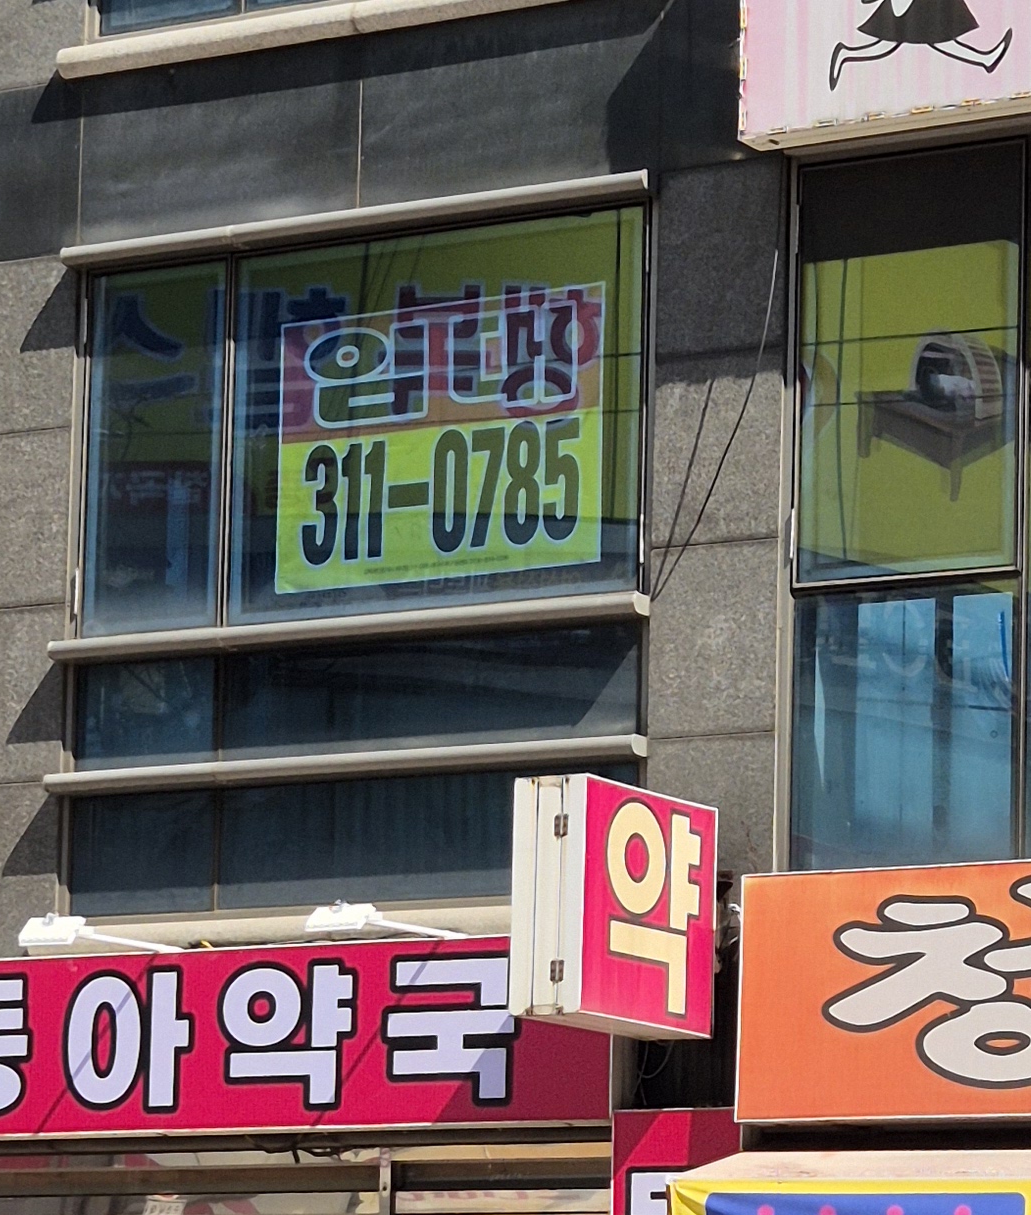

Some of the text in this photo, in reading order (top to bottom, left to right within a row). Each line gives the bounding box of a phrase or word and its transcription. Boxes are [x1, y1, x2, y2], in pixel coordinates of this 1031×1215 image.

[303, 299, 580, 428] 임대
[301, 417, 580, 566] 311-0785
[606, 797, 702, 1018] 약
